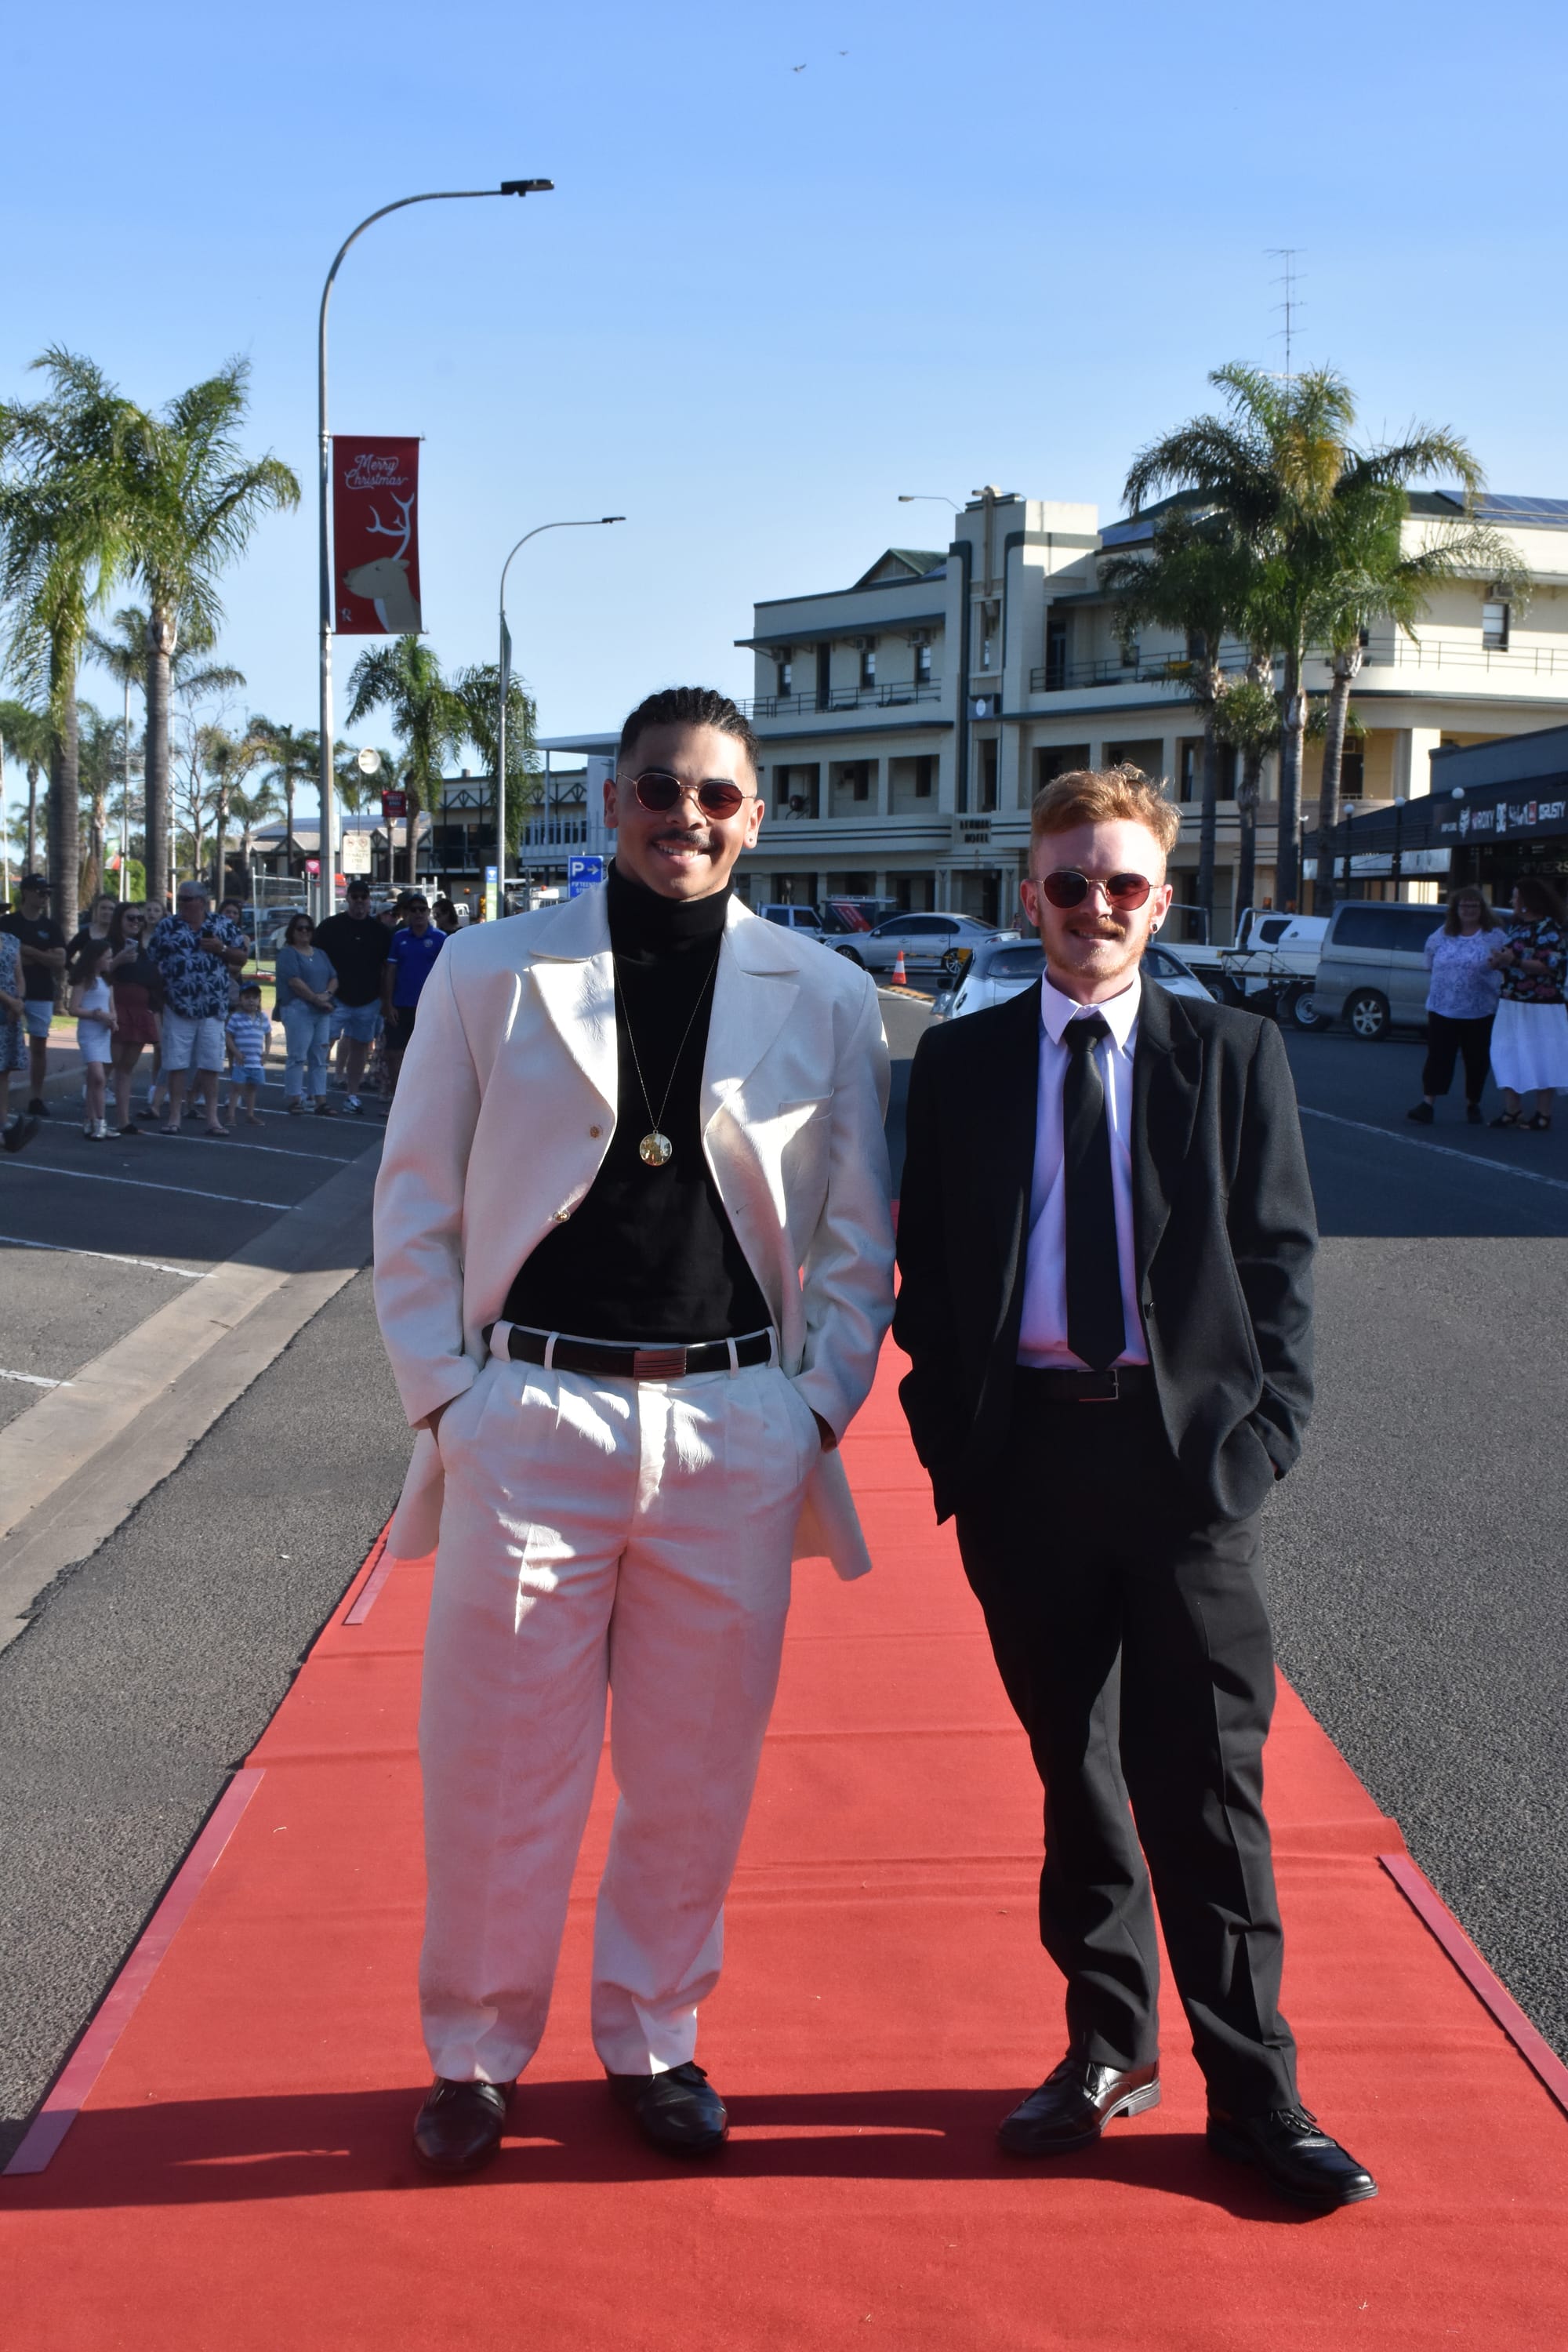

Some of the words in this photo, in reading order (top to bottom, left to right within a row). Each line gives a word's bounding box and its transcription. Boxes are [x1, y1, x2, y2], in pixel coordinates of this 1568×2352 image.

[354, 454, 399, 477] Merry
[344, 469, 409, 490] Christmas
[572, 862, 584, 877] P
